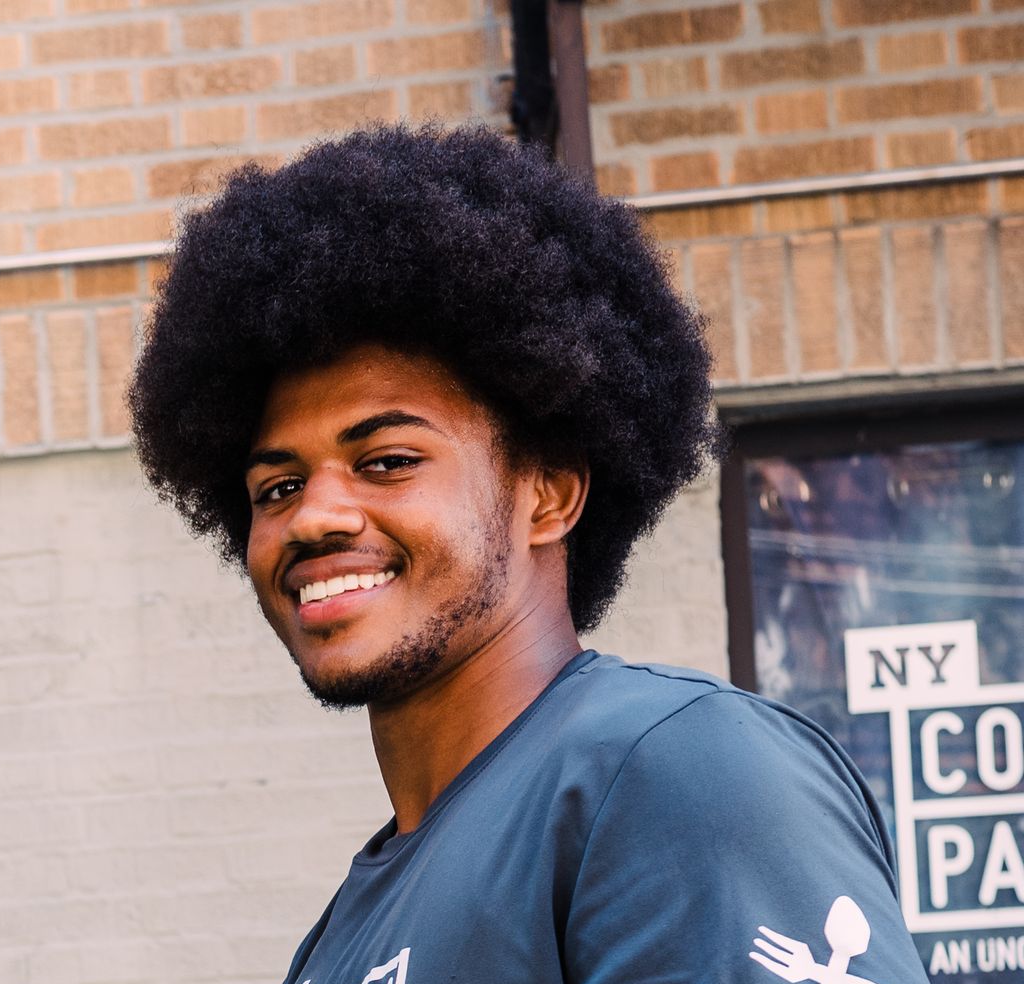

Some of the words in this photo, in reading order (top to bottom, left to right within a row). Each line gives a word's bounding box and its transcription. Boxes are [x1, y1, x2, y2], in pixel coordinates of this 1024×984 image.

[869, 644, 957, 689] NY
[920, 707, 1024, 794] CO
[929, 940, 971, 976] AN
